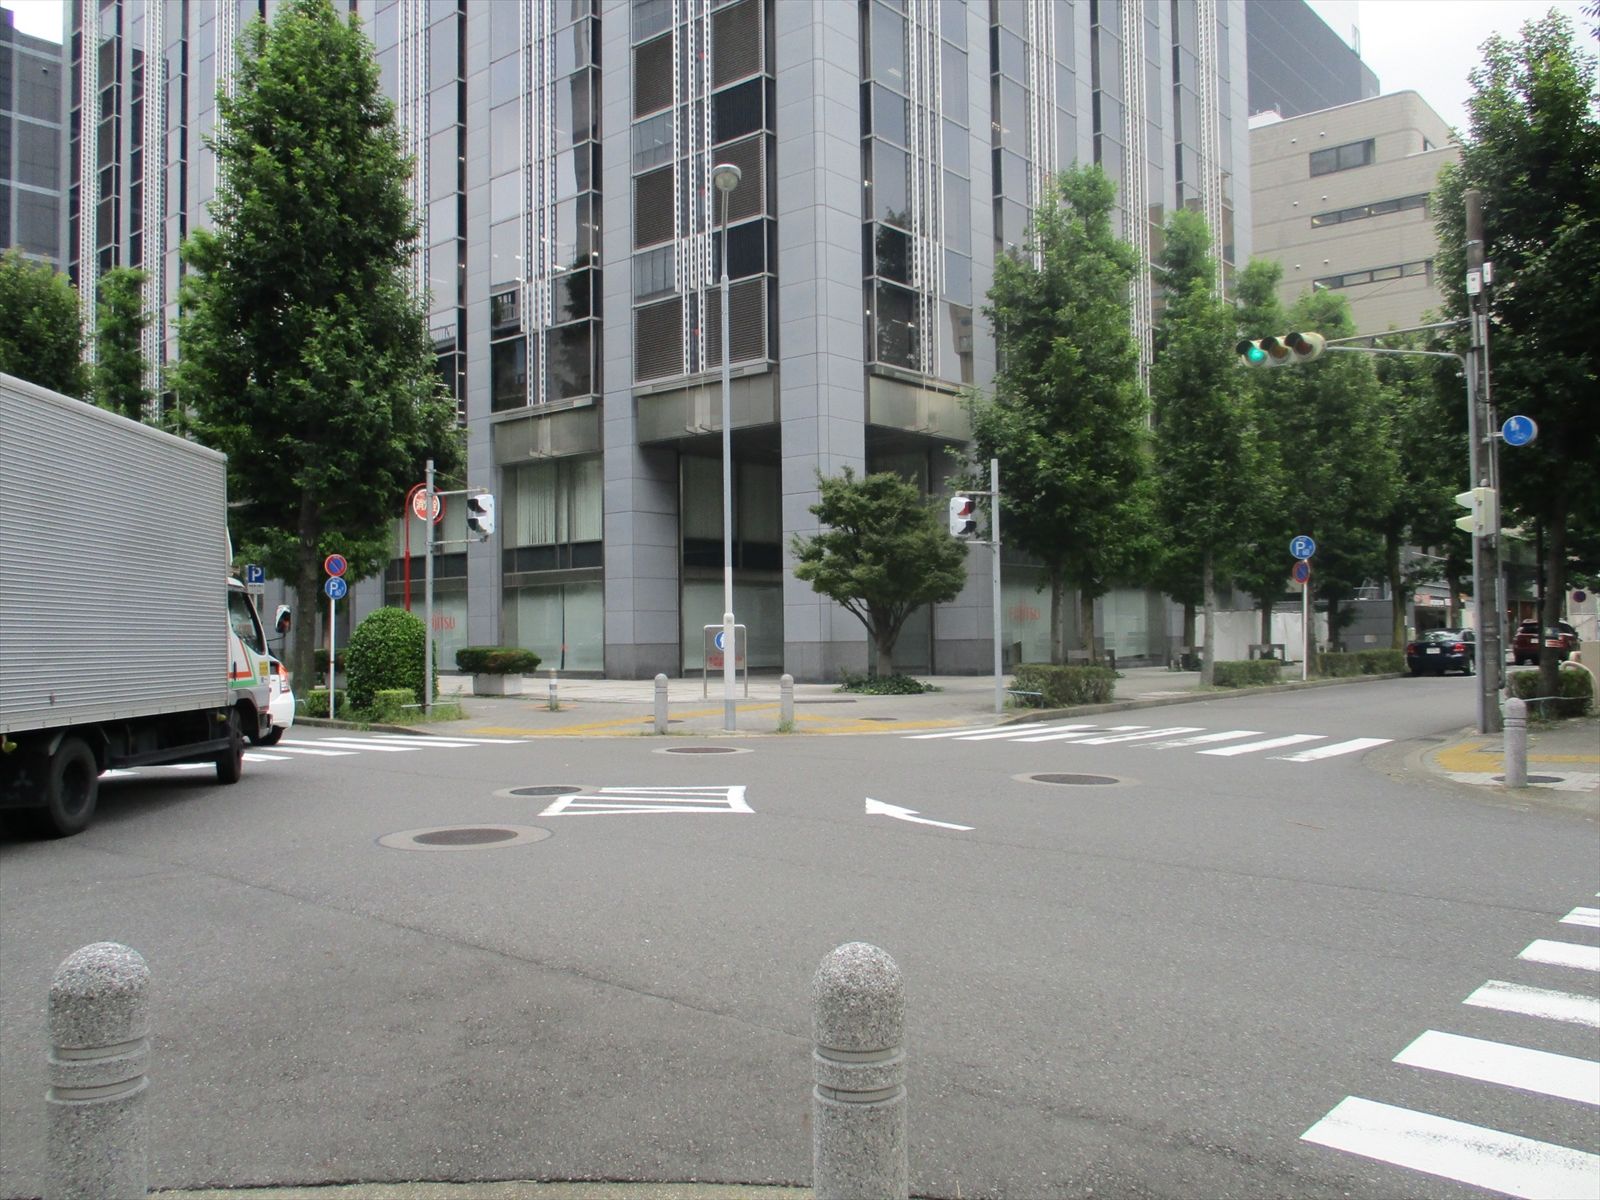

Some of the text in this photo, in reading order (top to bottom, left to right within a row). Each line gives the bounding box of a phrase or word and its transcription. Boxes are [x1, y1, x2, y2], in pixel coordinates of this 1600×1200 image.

[1296, 541, 1306, 556] P
[252, 566, 262, 581] P
[330, 581, 339, 595] P
